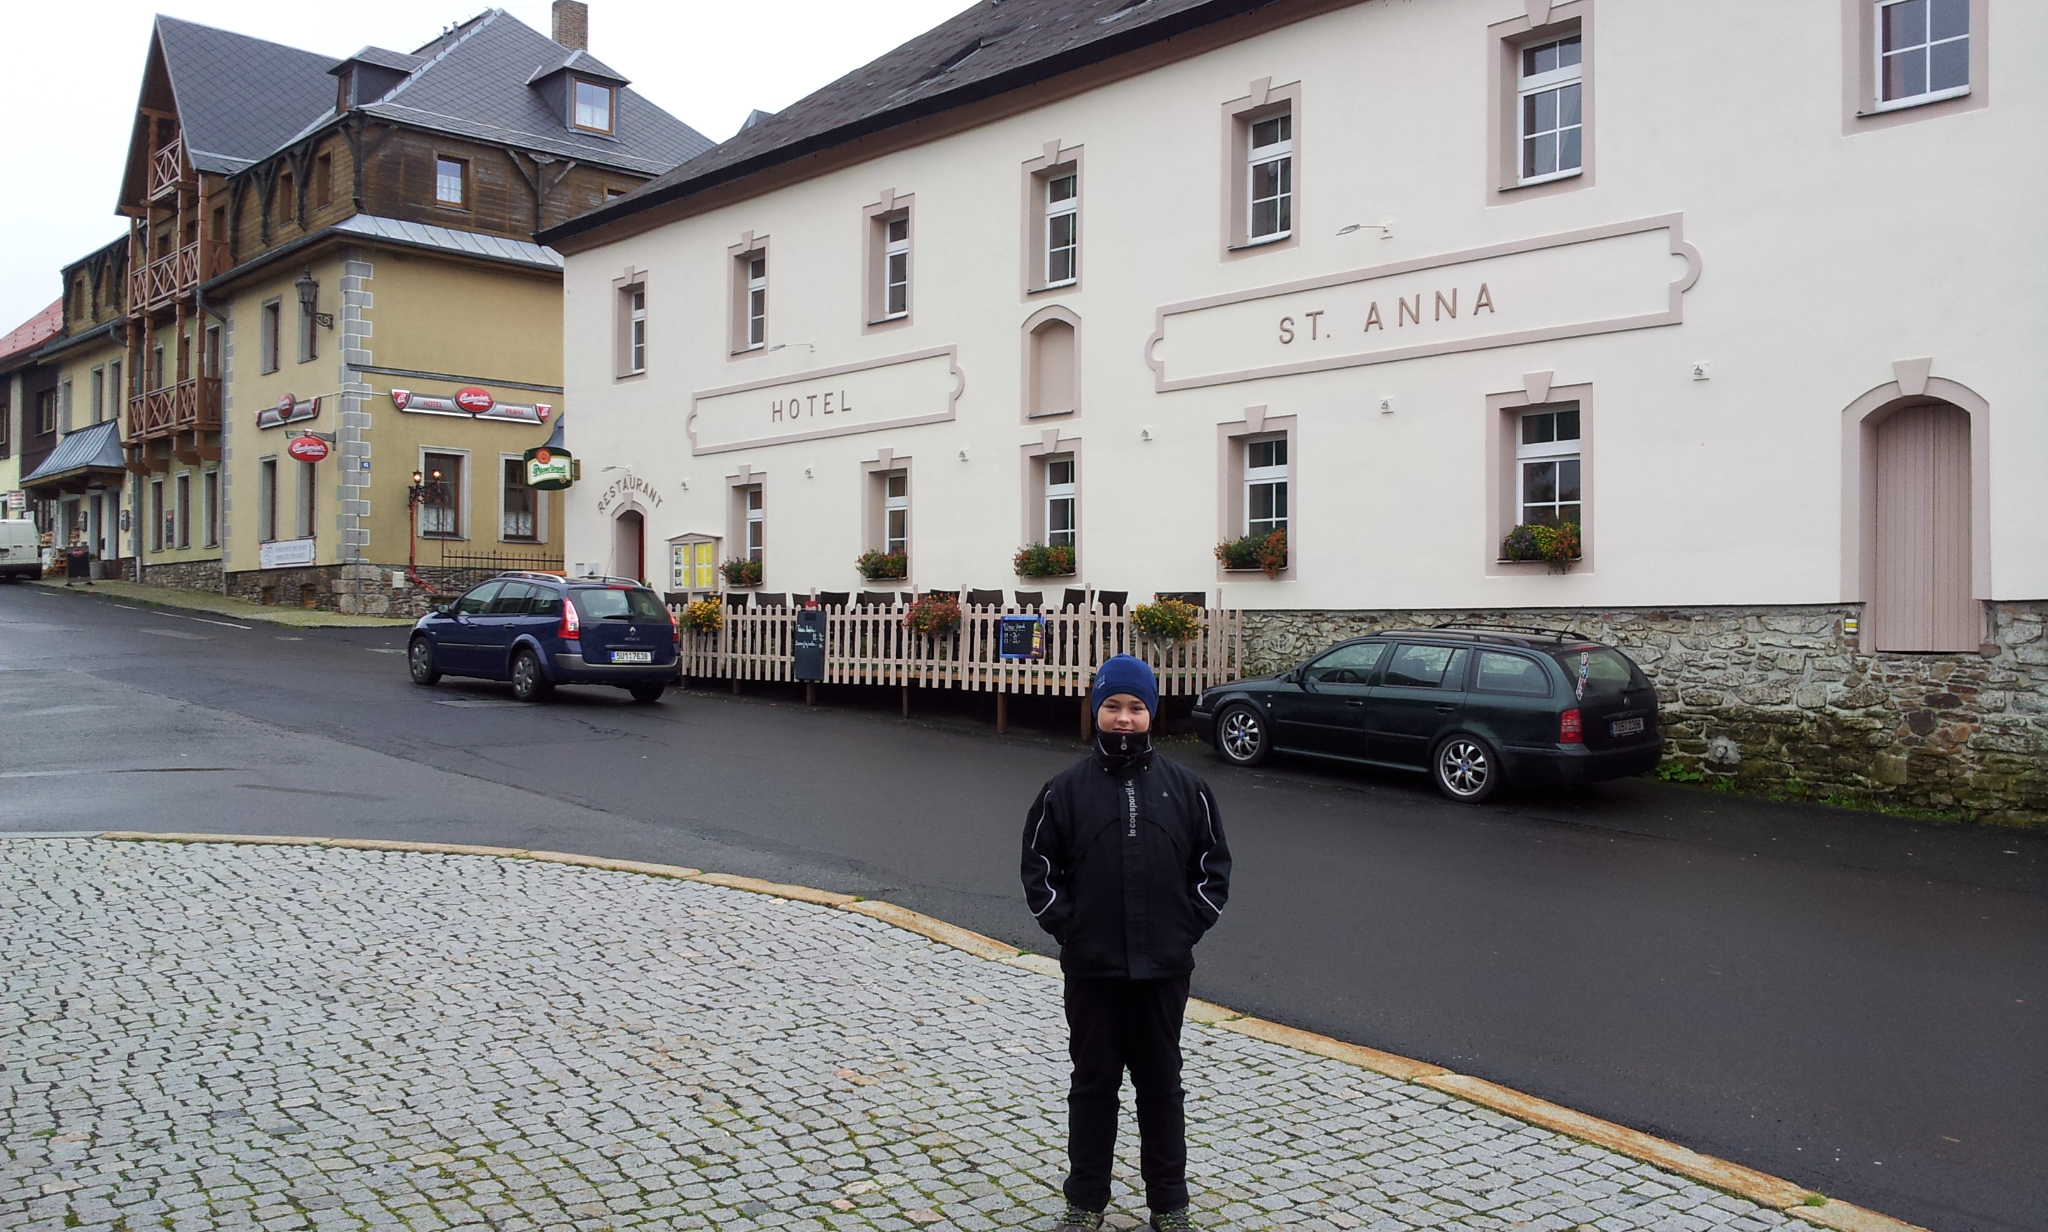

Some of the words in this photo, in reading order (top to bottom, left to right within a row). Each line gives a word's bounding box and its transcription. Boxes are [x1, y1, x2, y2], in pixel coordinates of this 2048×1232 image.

[1279, 310, 1330, 344] ST.
[1364, 282, 1495, 332] ANNA
[423, 400, 444, 408] HOTEL
[505, 408, 525, 416] PRAHA
[772, 390, 852, 423] HOTEL
[598, 476, 663, 514] RESTAURANT
[1125, 788, 1138, 812] sportif
[1129, 813, 1138, 828] coq
[1128, 829, 1136, 837] le
